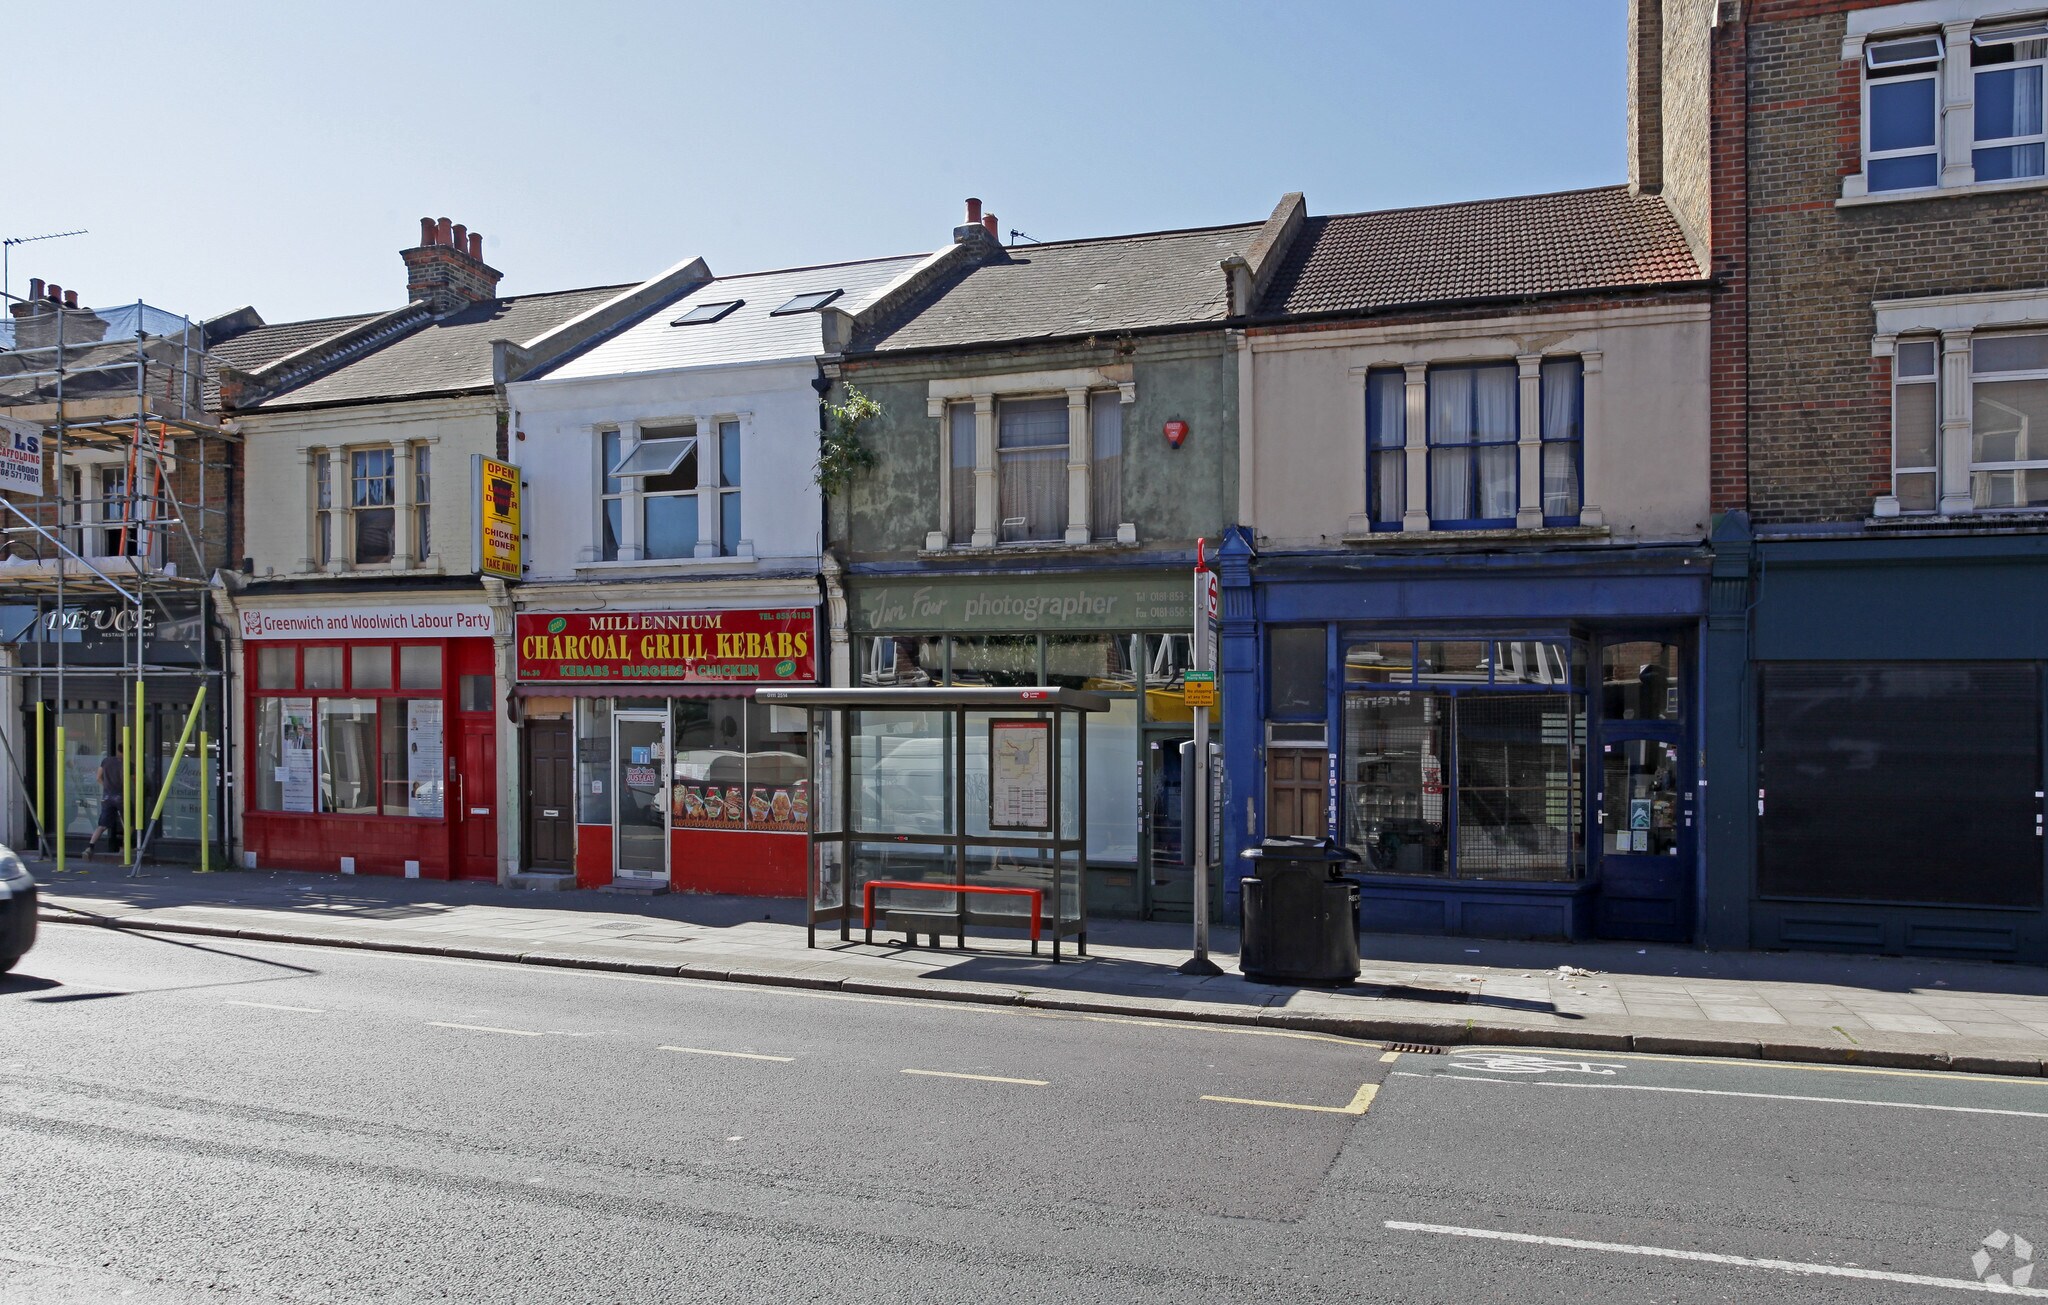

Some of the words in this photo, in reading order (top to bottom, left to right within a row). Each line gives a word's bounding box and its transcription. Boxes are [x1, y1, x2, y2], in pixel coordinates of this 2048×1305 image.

[488, 463, 515, 480] OPEN
[484, 527, 519, 542] CHICKEN
[489, 538, 516, 551] DONER
[486, 558, 500, 570] TAKE
[501, 561, 518, 573] AWAY
[964, 591, 1118, 622] photographer
[44, 607, 155, 631] DEUCE
[264, 616, 324, 631] Greenwich
[327, 615, 349, 630] and
[351, 613, 408, 629] Woolwich
[410, 612, 453, 628] Labour
[456, 612, 490, 630] Party
[589, 615, 722, 630] MILLENNIUM
[522, 634, 632, 661] CHARCOAL
[640, 633, 708, 660] GRILL
[716, 631, 808, 659] KEBABS
[559, 665, 609, 677] KEBABS
[621, 665, 685, 677] BURGERS
[697, 664, 760, 677] CHICKEN
